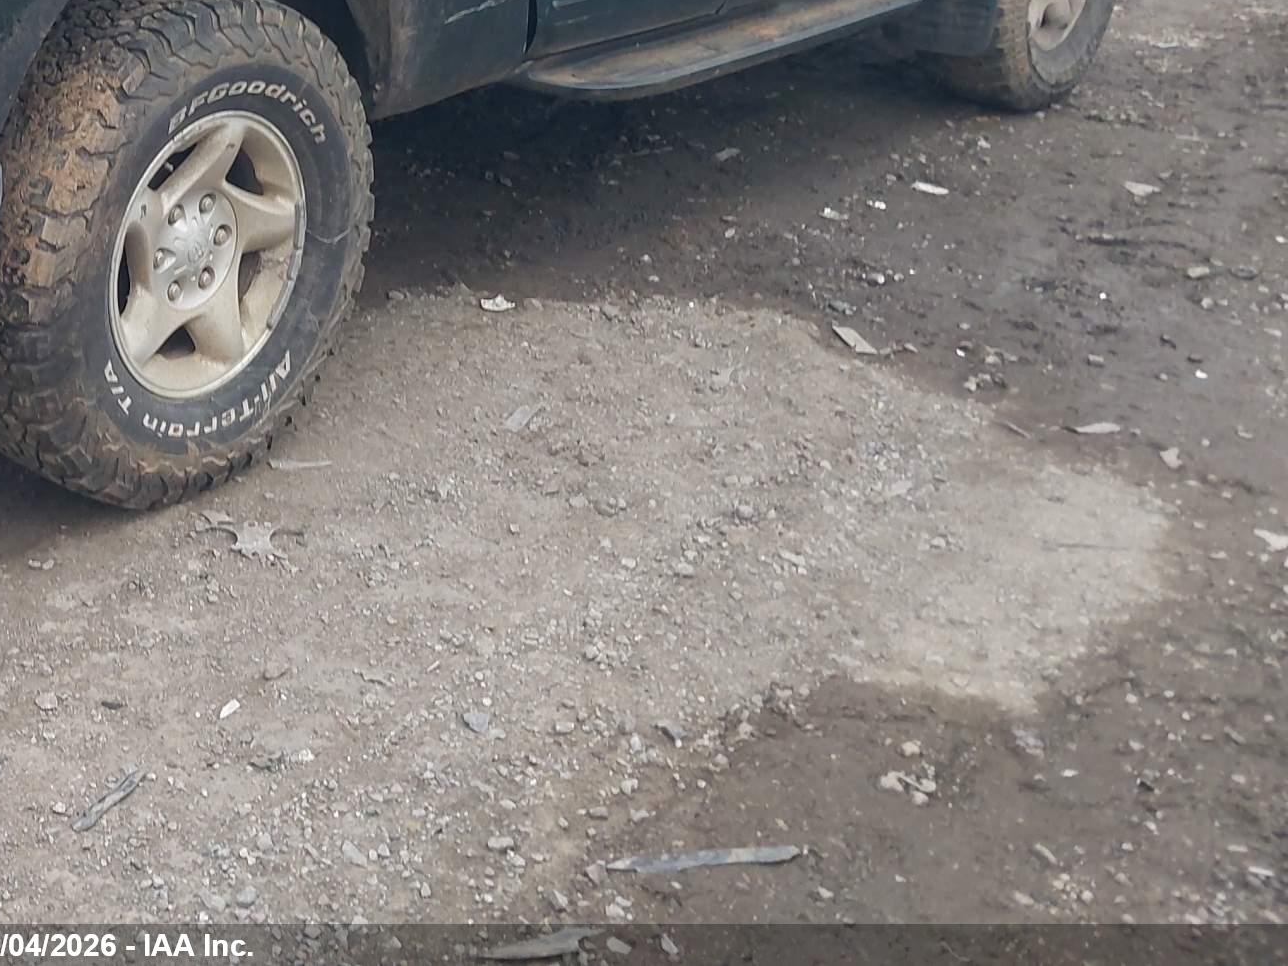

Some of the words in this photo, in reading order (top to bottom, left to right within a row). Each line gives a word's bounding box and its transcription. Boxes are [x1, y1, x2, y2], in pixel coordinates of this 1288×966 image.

[168, 80, 327, 144] BFGoodrich
[104, 359, 133, 415] T/A
[143, 349, 291, 438] All-Terrain
